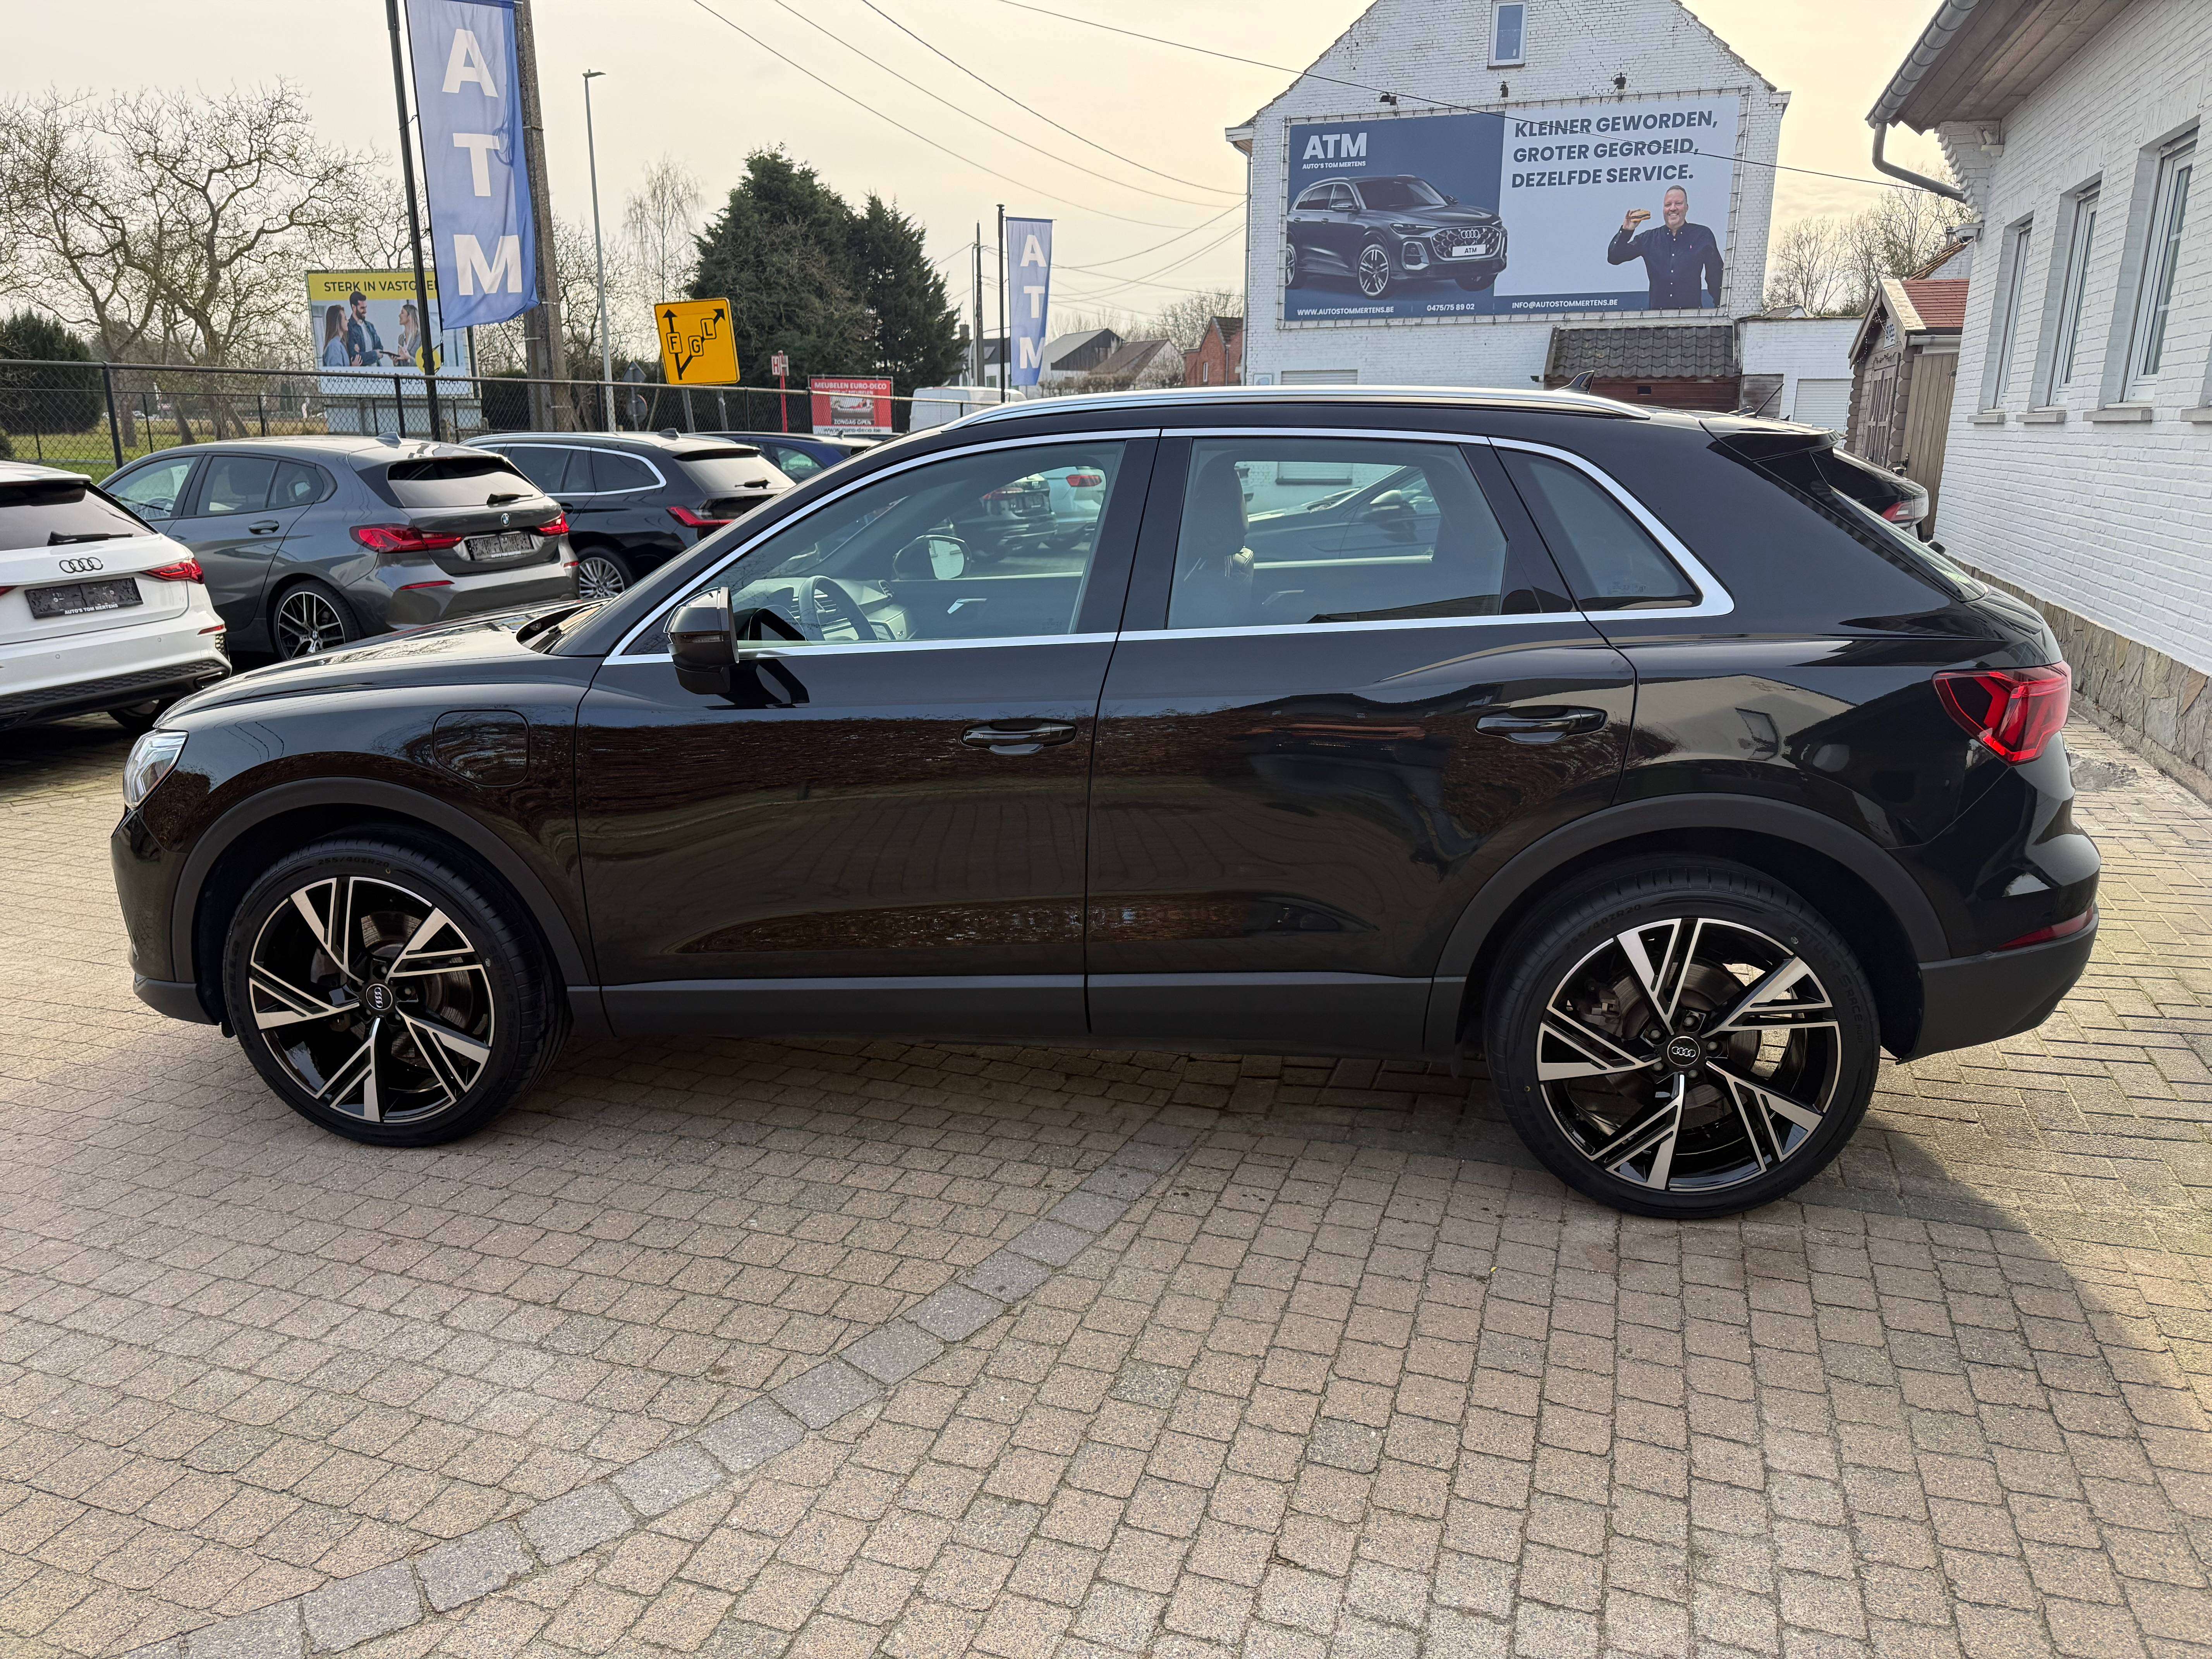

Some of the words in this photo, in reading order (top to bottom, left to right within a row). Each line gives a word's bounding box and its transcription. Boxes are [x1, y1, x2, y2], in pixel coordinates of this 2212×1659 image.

[1515, 118, 1592, 138] KLEINER
[1596, 110, 1718, 132] GEWORDEN,
[1303, 132, 1367, 160] ATM
[1513, 144, 1589, 163] GROTER
[1593, 138, 1699, 158] GEGROEID,
[442, 28, 522, 295] ATM
[1511, 169, 1602, 188] DEZELFDE
[1606, 164, 1694, 183] SERVICE.
[324, 281, 360, 292] STERK
[364, 281, 376, 291] IN
[378, 280, 437, 291] VASTGE
[1019, 235, 1047, 369] ATM
[1297, 306, 1394, 316] WWW.AUTOSTOMMERTENS.BE
[1512, 299, 1618, 309] INFO@AUTOSTOMMERTENS.BE
[704, 322, 713, 336] L
[670, 336, 677, 350] F
[691, 339, 701, 353] G
